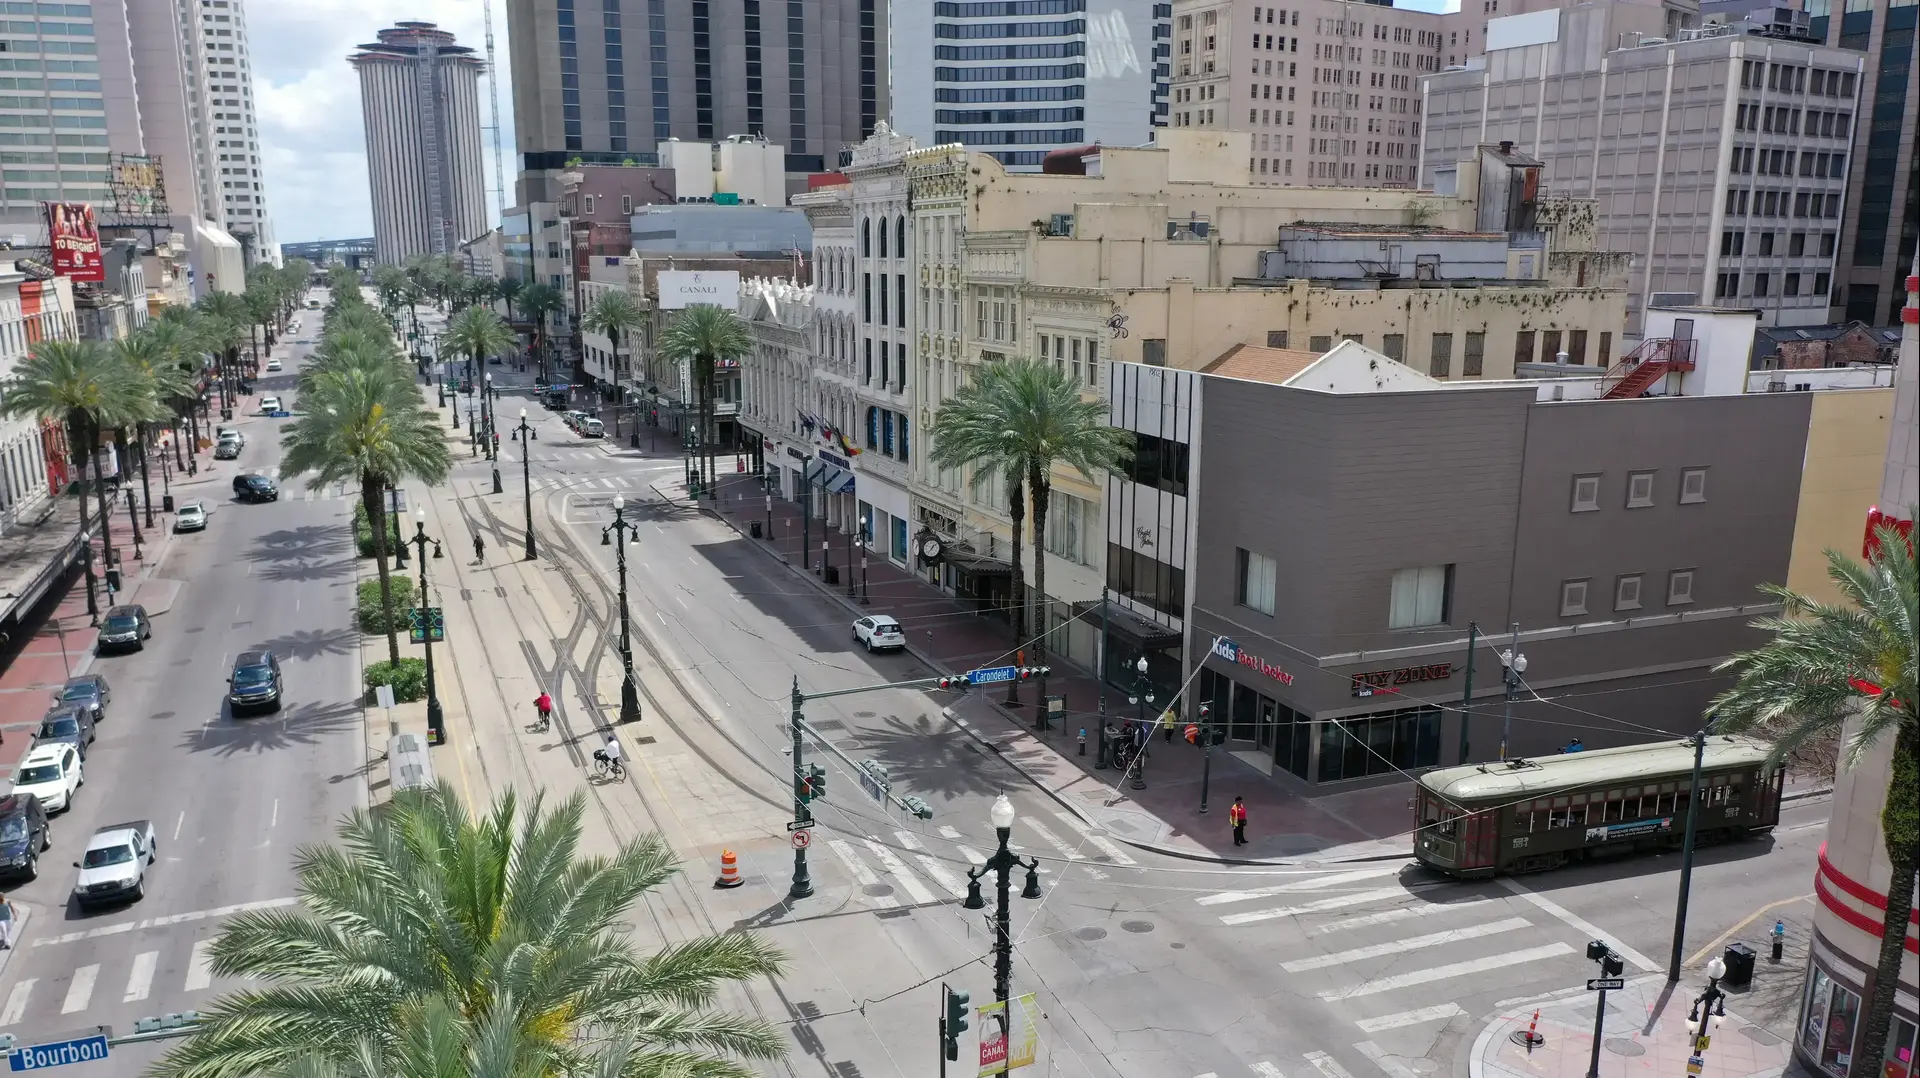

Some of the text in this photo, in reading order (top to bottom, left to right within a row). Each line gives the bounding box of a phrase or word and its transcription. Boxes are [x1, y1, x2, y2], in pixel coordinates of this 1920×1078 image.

[55, 239, 97, 253] TO BEIGNET
[680, 286, 717, 294] CANALI
[1212, 637, 1236, 661] Kids
[1259, 658, 1294, 686] Locker
[976, 668, 1010, 682] Carondelet
[1352, 662, 1451, 689] FLY ZONE
[1699, 1038, 1708, 1049] K
[21, 1041, 104, 1069] Bourbon
[982, 1045, 1005, 1059] CANAL
[1010, 1043, 1036, 1062] NOLA
